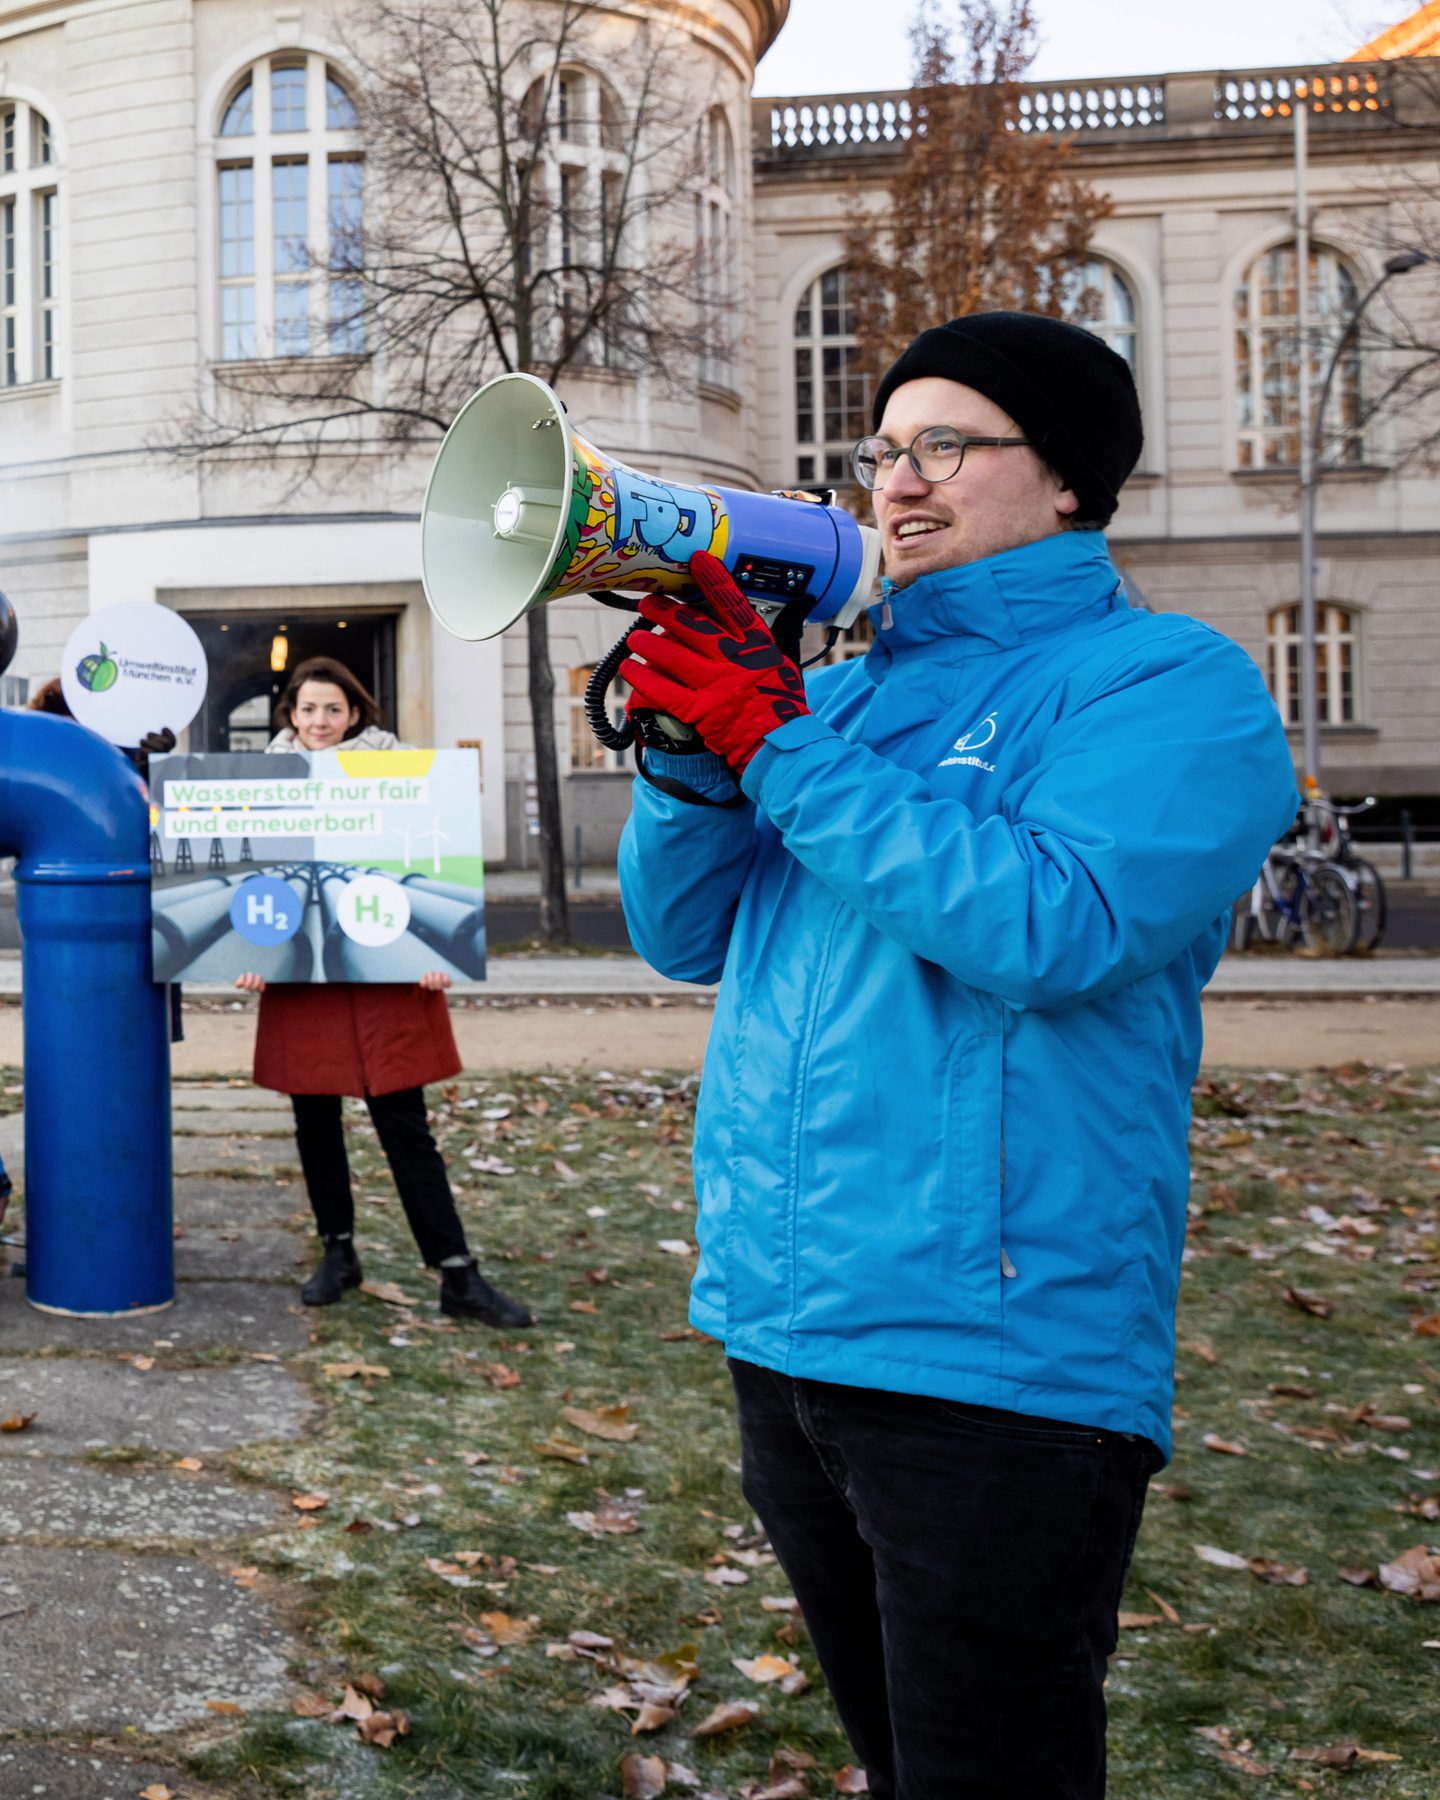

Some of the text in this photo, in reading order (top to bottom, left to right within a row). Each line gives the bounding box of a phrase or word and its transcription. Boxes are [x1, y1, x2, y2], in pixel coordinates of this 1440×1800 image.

[171, 781, 423, 803] Wasserstoff nur fair
[172, 812, 376, 833] und erneuerbar!
[246, 895, 289, 930] H2
[354, 895, 394, 928] H2
